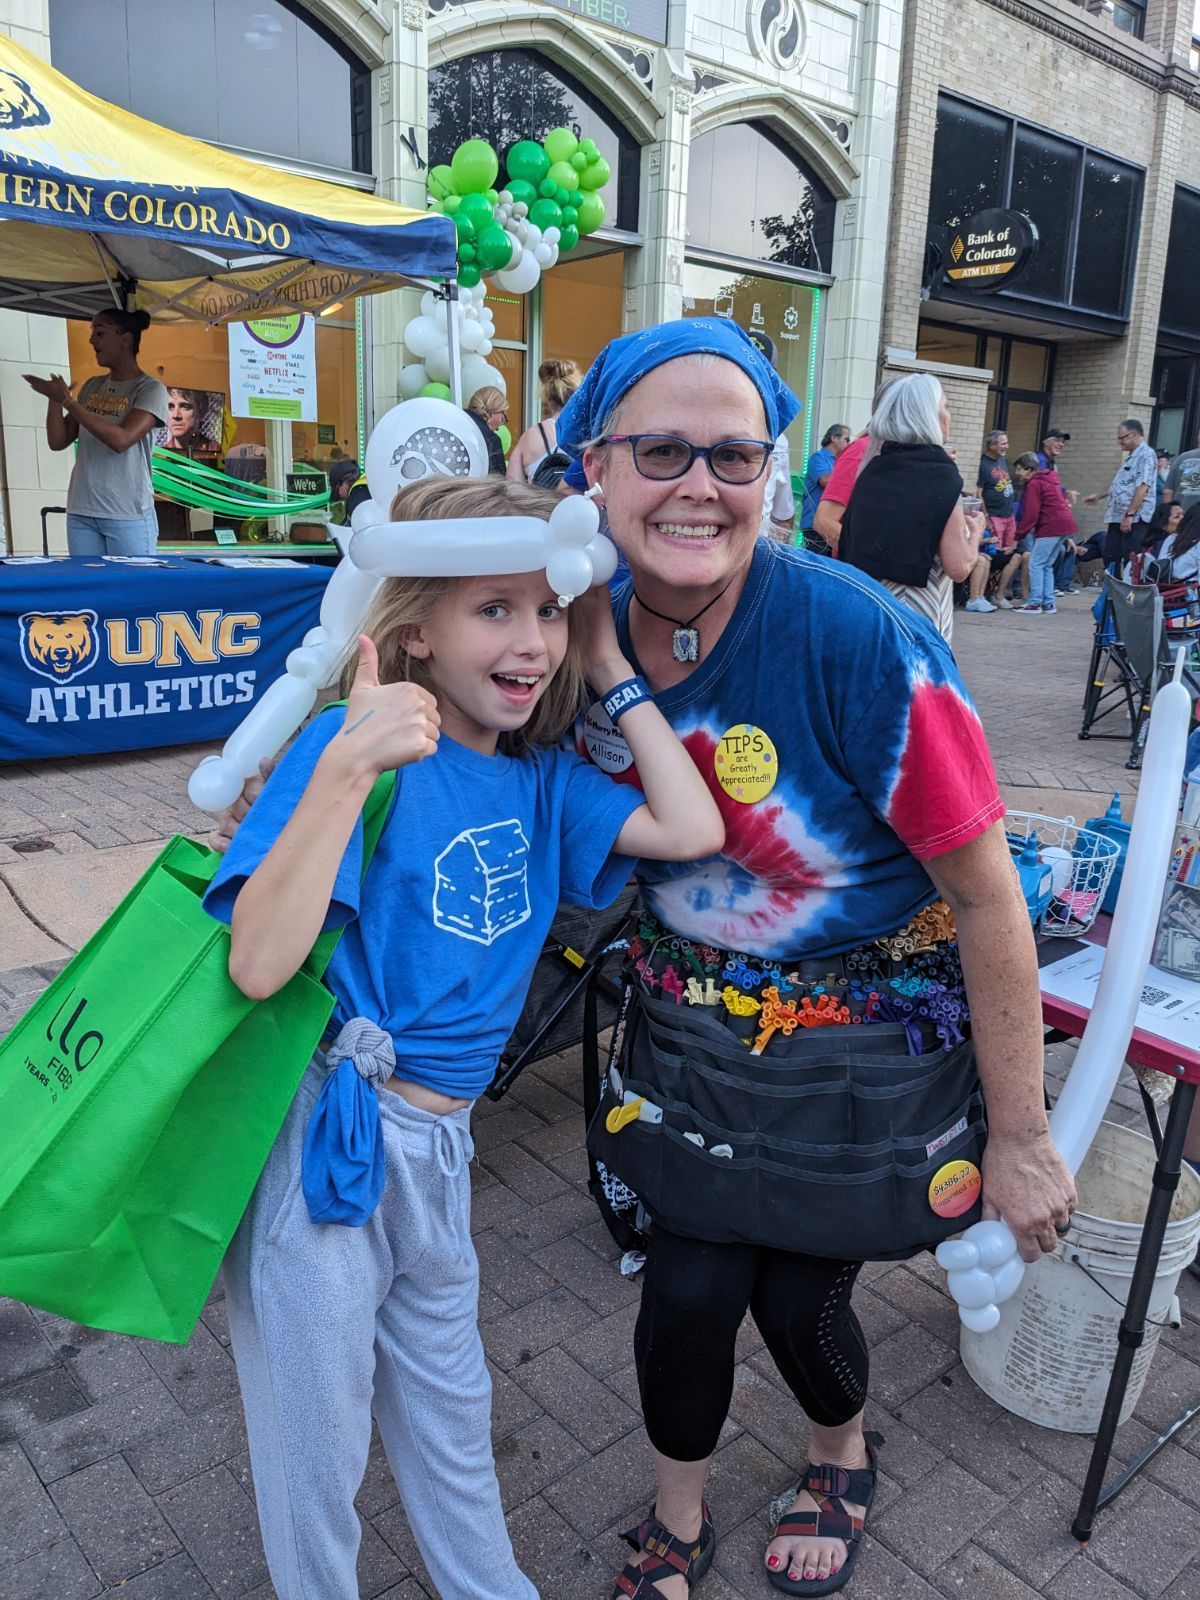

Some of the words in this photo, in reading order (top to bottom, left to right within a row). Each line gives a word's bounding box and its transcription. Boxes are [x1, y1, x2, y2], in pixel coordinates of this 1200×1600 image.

[104, 191, 290, 249] COLORADO
[967, 230, 994, 246] Bank
[997, 227, 1011, 241] of
[965, 244, 1016, 262] Colorado
[962, 267, 980, 278] ATM
[981, 265, 1001, 275] LIVE
[780, 331, 800, 341] Support
[264, 367, 289, 377] NETFLIX
[293, 479, 317, 491] We're
[104, 609, 262, 668] UNC
[26, 670, 257, 723] ATHLETICS
[590, 742, 625, 765] Allison
[722, 734, 764, 754] TIPS
[730, 763, 757, 773] Greatly
[720, 773, 771, 786] Appreciated!!!
[27, 1060, 50, 1087] YEARS
[933, 1185, 967, 1208] Suggested
[968, 1176, 981, 1187] Tip
